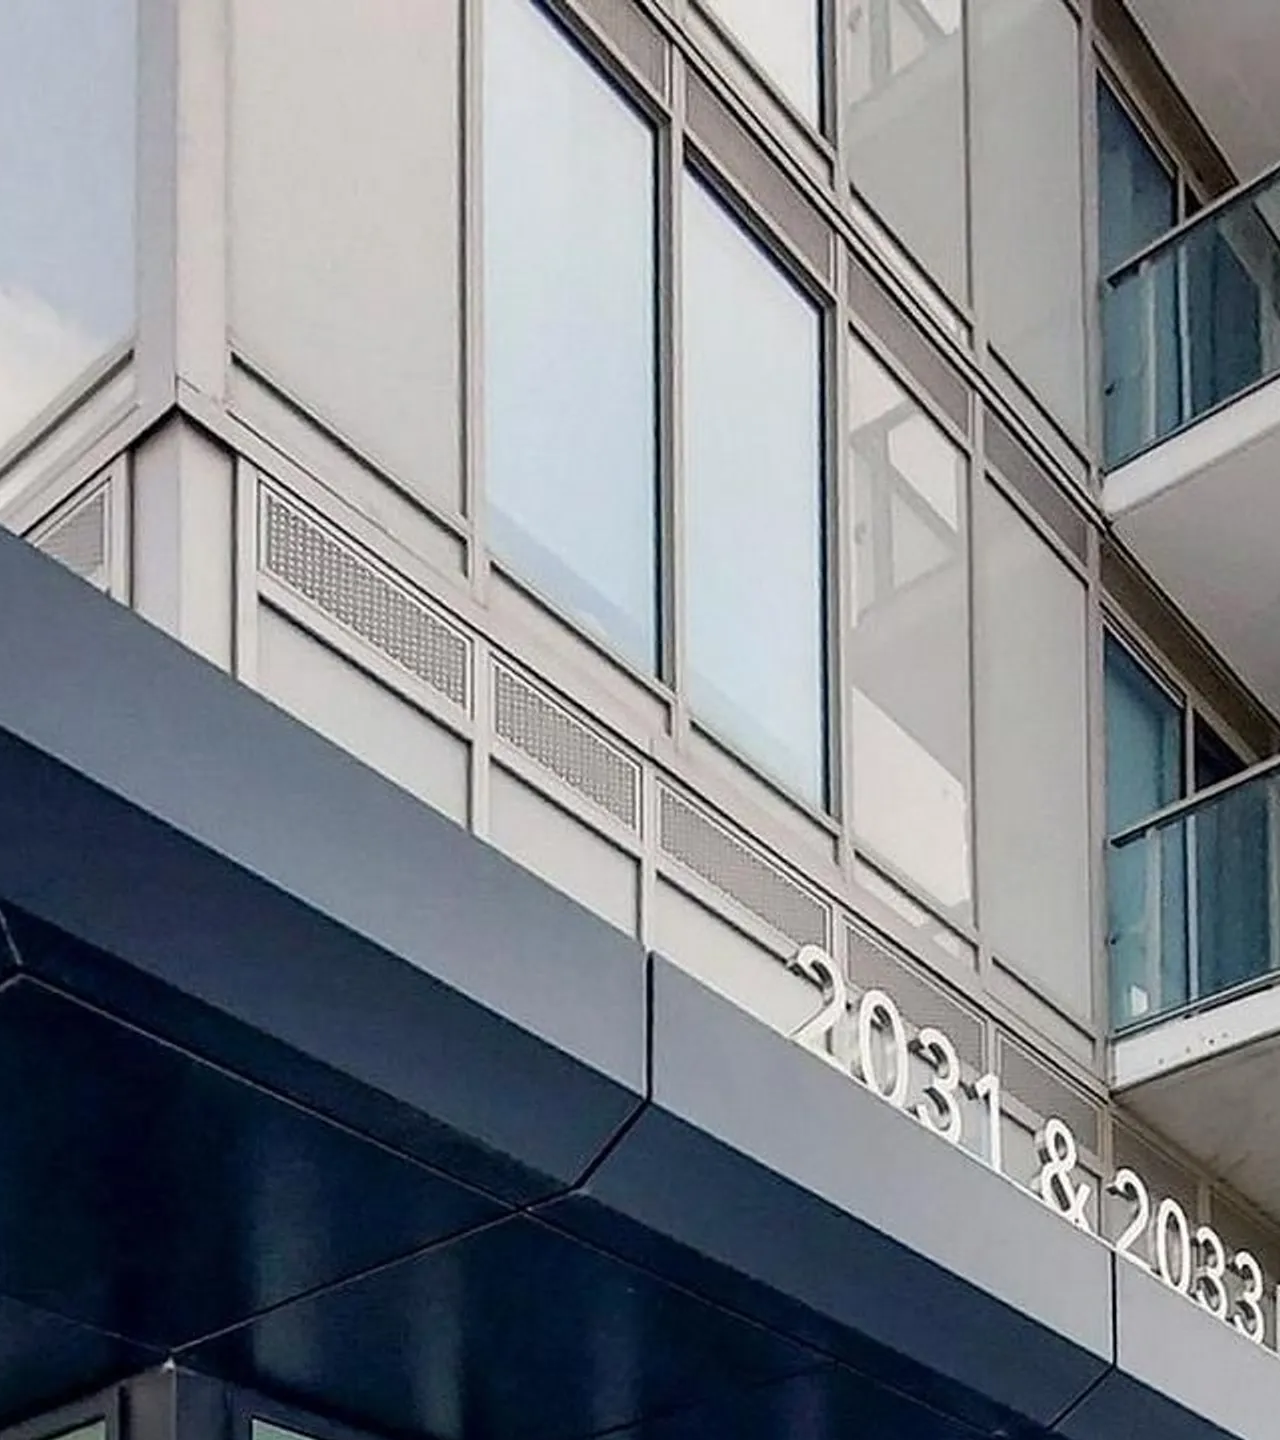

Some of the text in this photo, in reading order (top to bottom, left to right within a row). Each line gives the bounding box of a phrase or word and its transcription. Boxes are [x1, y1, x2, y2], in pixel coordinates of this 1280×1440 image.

[793, 944, 1002, 1175] 2031
[1038, 1116, 1092, 1233] &
[1112, 1168, 1265, 1345] 2033
